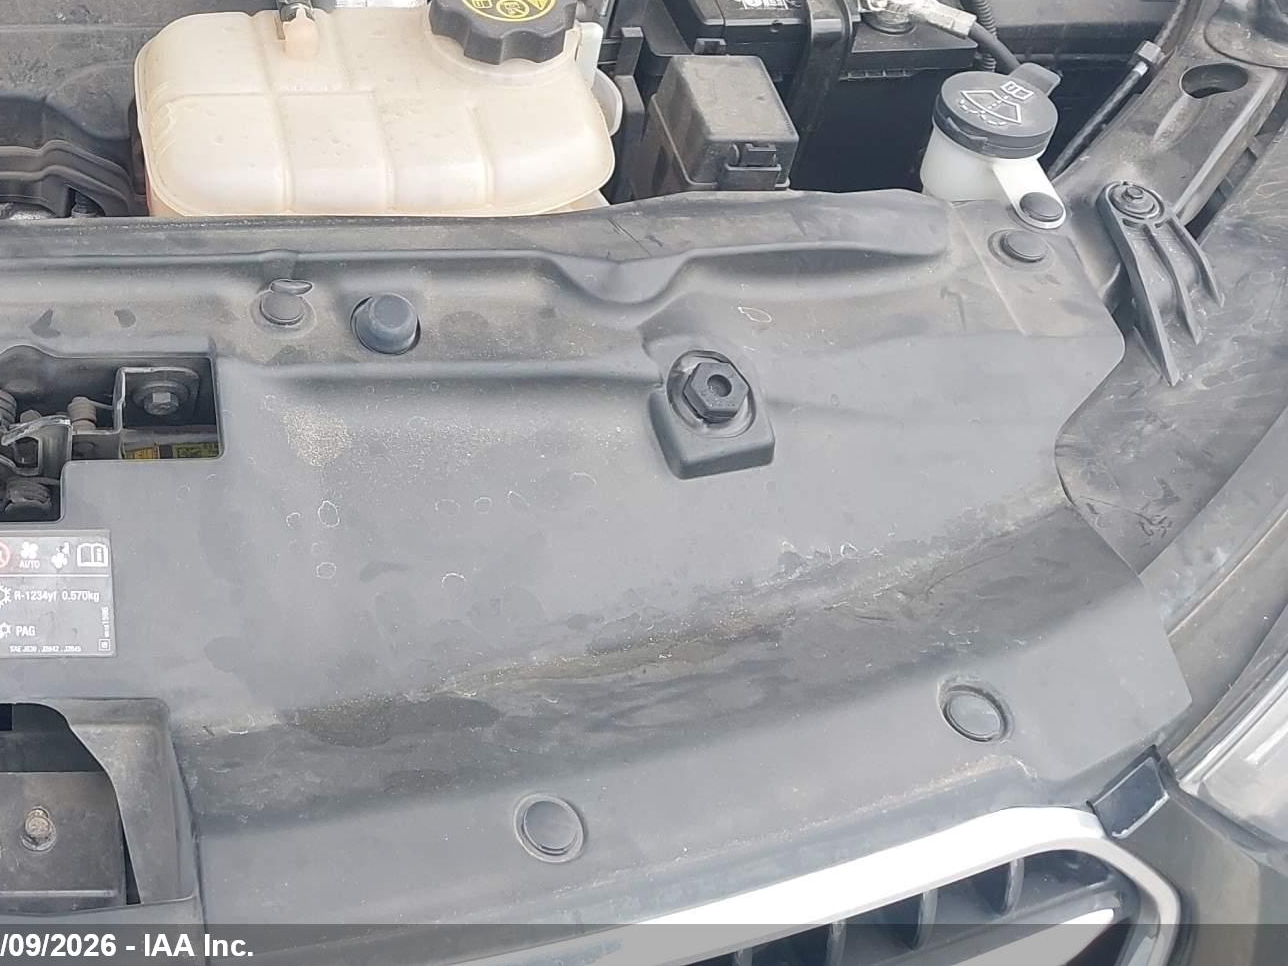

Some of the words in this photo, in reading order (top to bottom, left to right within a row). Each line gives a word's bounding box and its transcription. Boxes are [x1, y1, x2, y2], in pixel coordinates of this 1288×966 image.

[19, 560, 41, 569] AUTO
[14, 590, 57, 602] R-1234yf
[62, 590, 100, 602] 0.570kg
[16, 626, 37, 637] PAG
